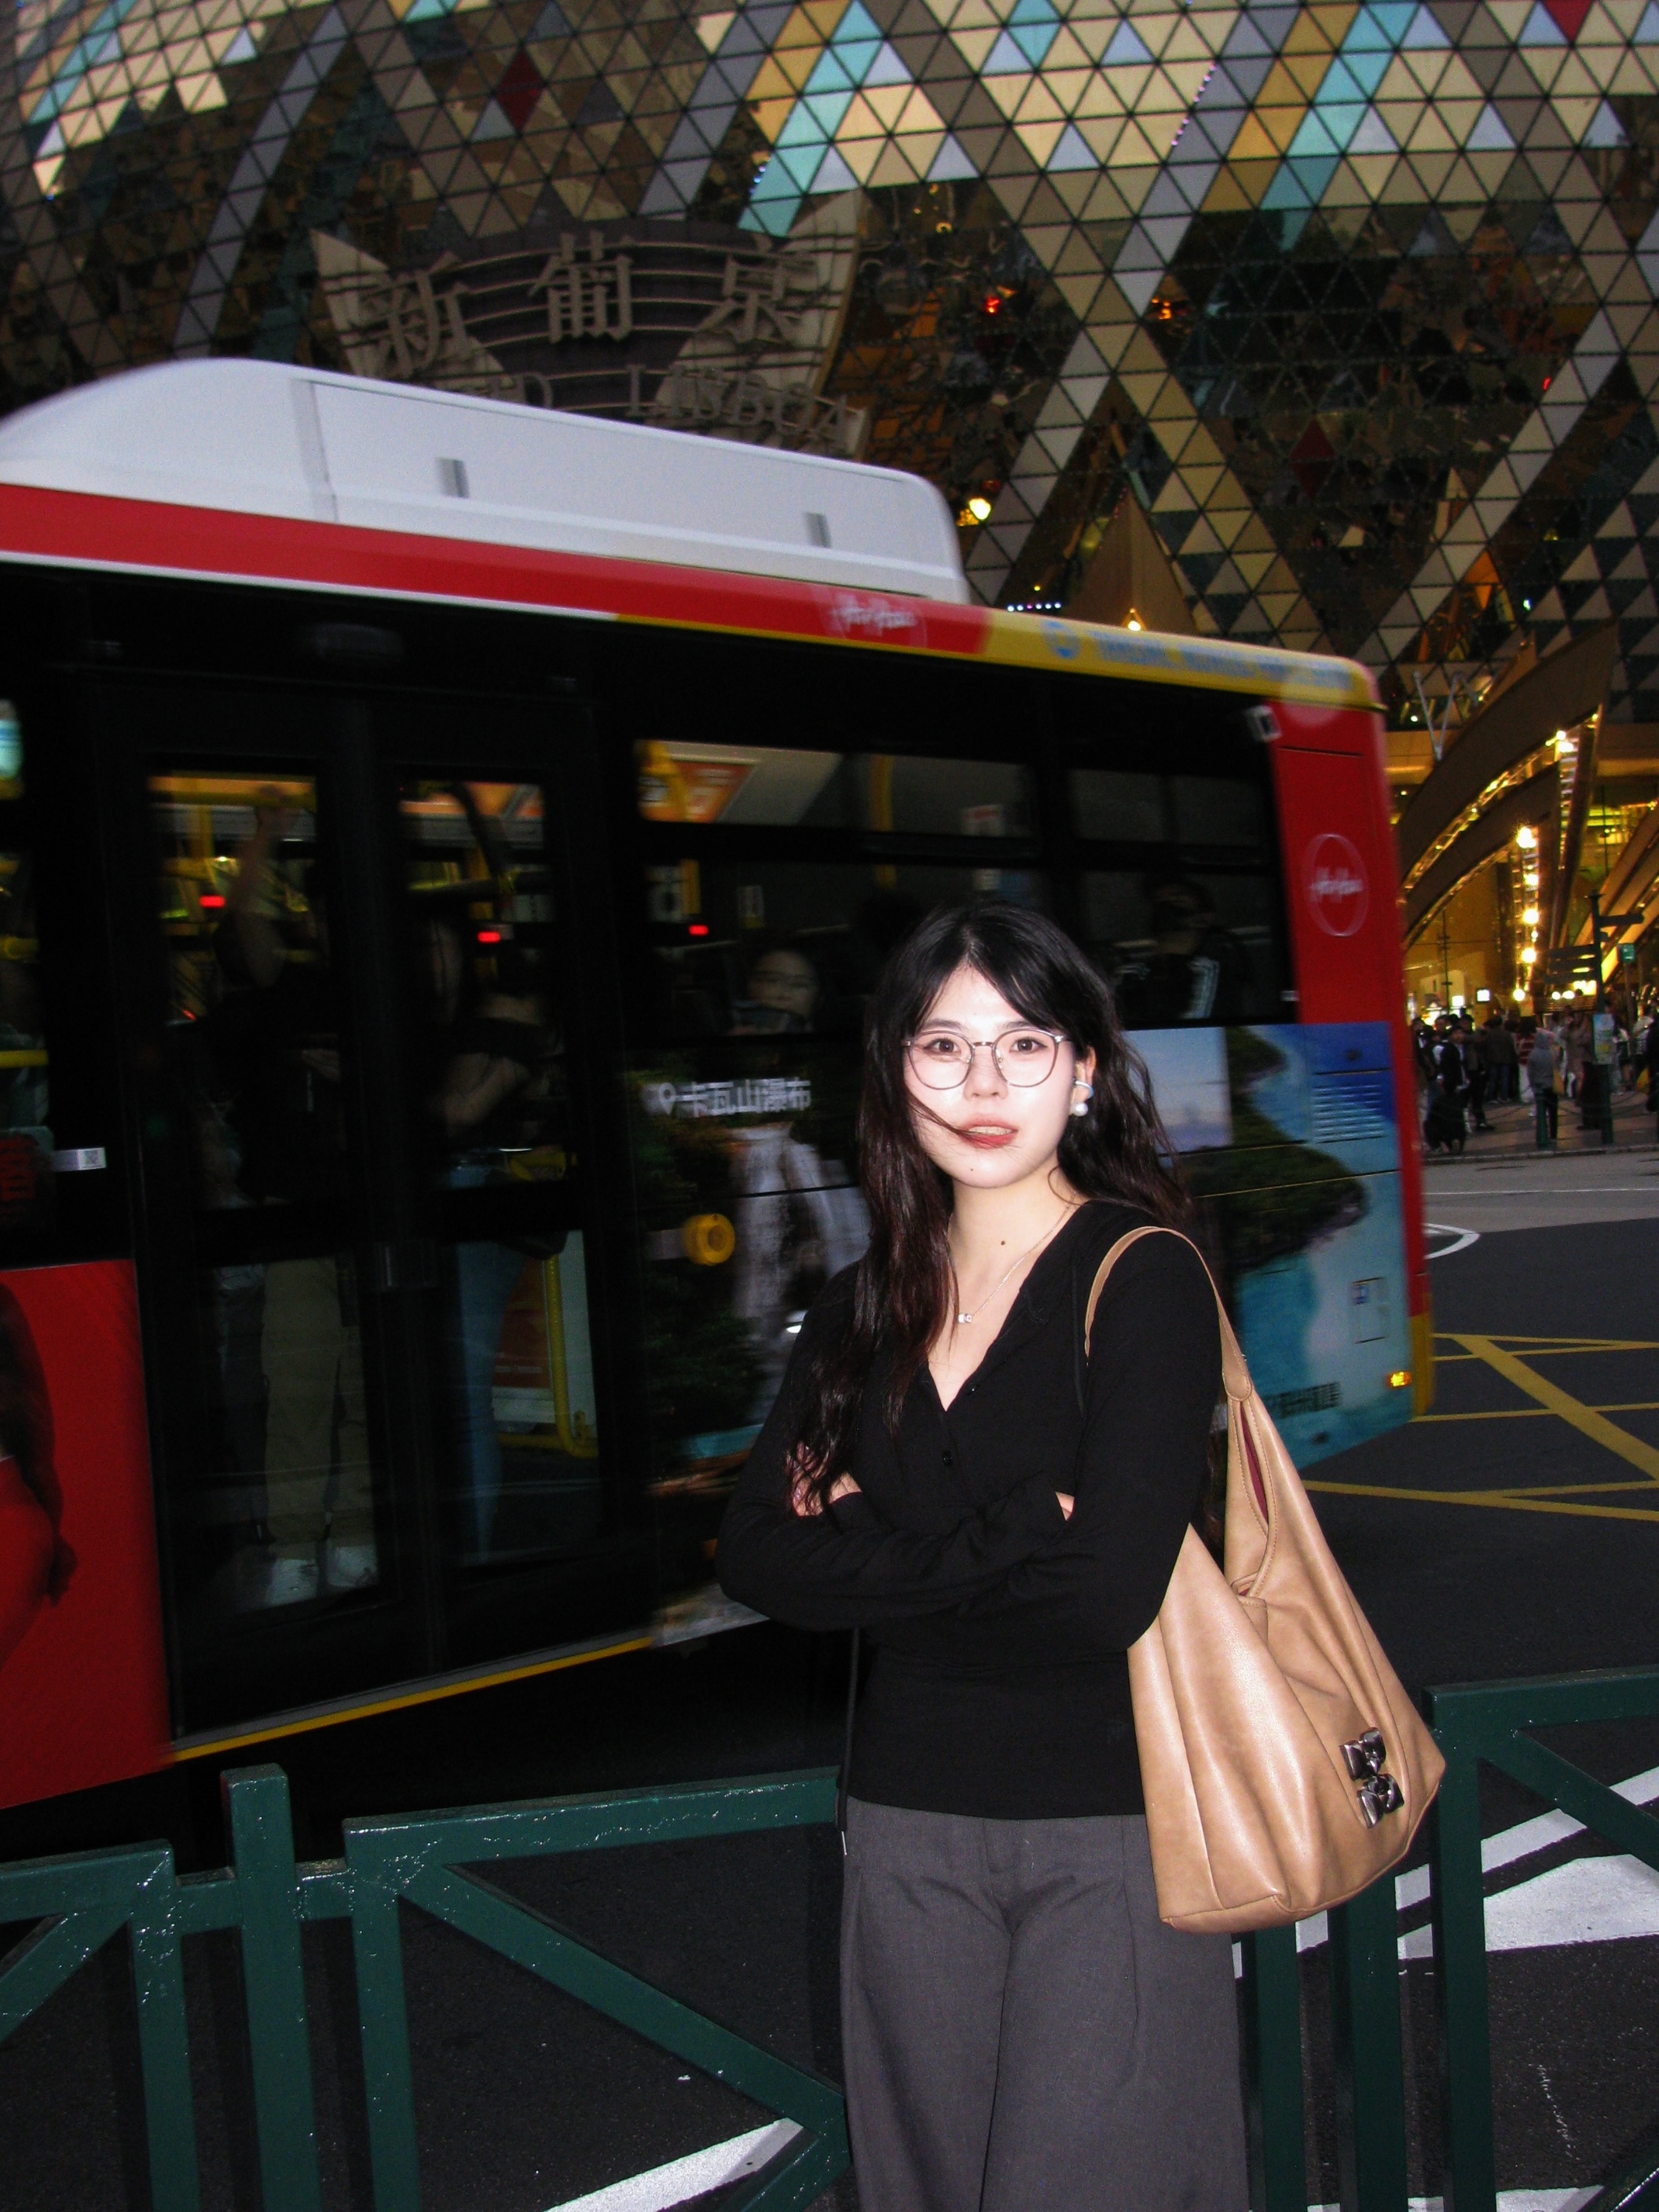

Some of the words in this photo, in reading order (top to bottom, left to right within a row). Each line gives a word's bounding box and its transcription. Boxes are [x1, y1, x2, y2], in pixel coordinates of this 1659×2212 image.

[359, 231, 819, 379] 新葡京
[625, 364, 848, 445] LISBOA
